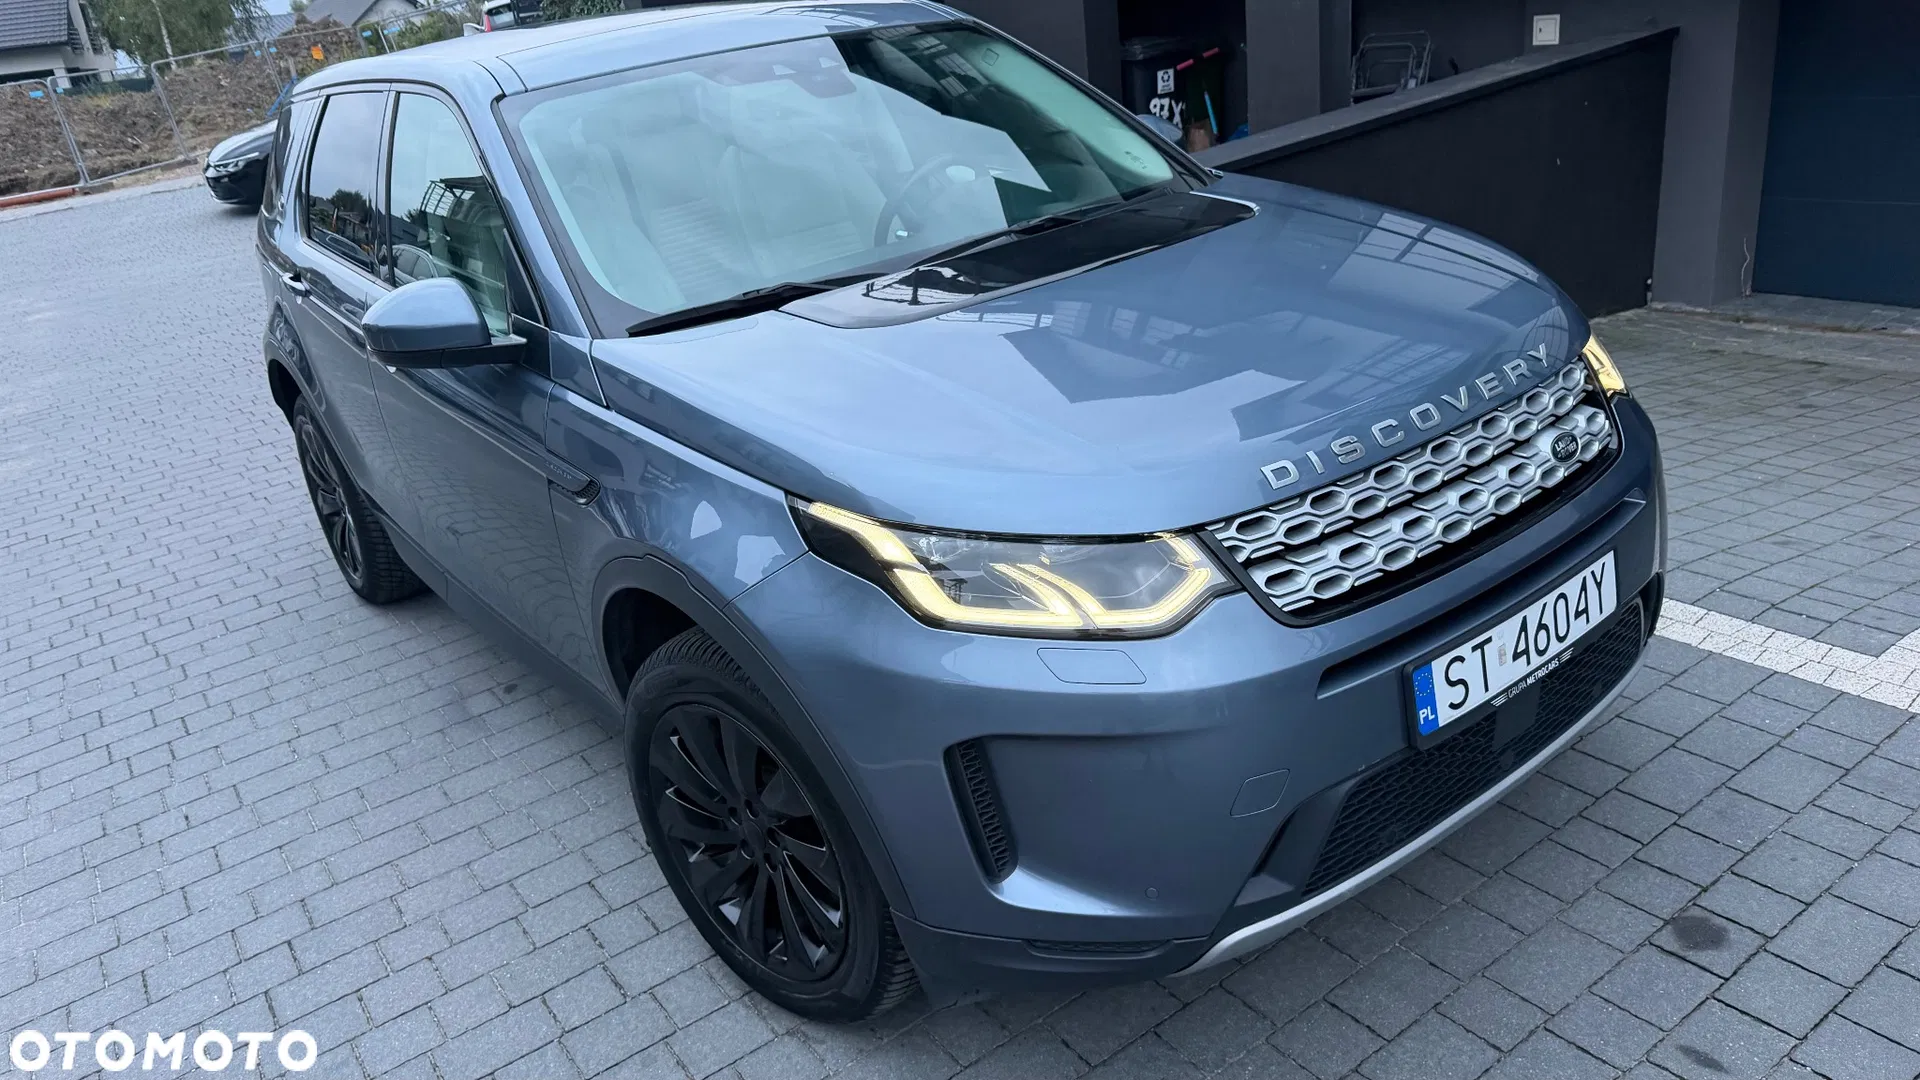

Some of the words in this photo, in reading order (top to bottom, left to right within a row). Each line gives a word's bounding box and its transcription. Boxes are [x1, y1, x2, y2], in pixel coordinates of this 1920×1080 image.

[1260, 343, 1551, 490] DISCOVERY
[1444, 635, 1493, 710] ST
[1512, 561, 1606, 668] 4604Y
[1508, 680, 1527, 698] GRUPA
[1527, 657, 1559, 686] METROCARS
[1419, 705, 1436, 726] PL
